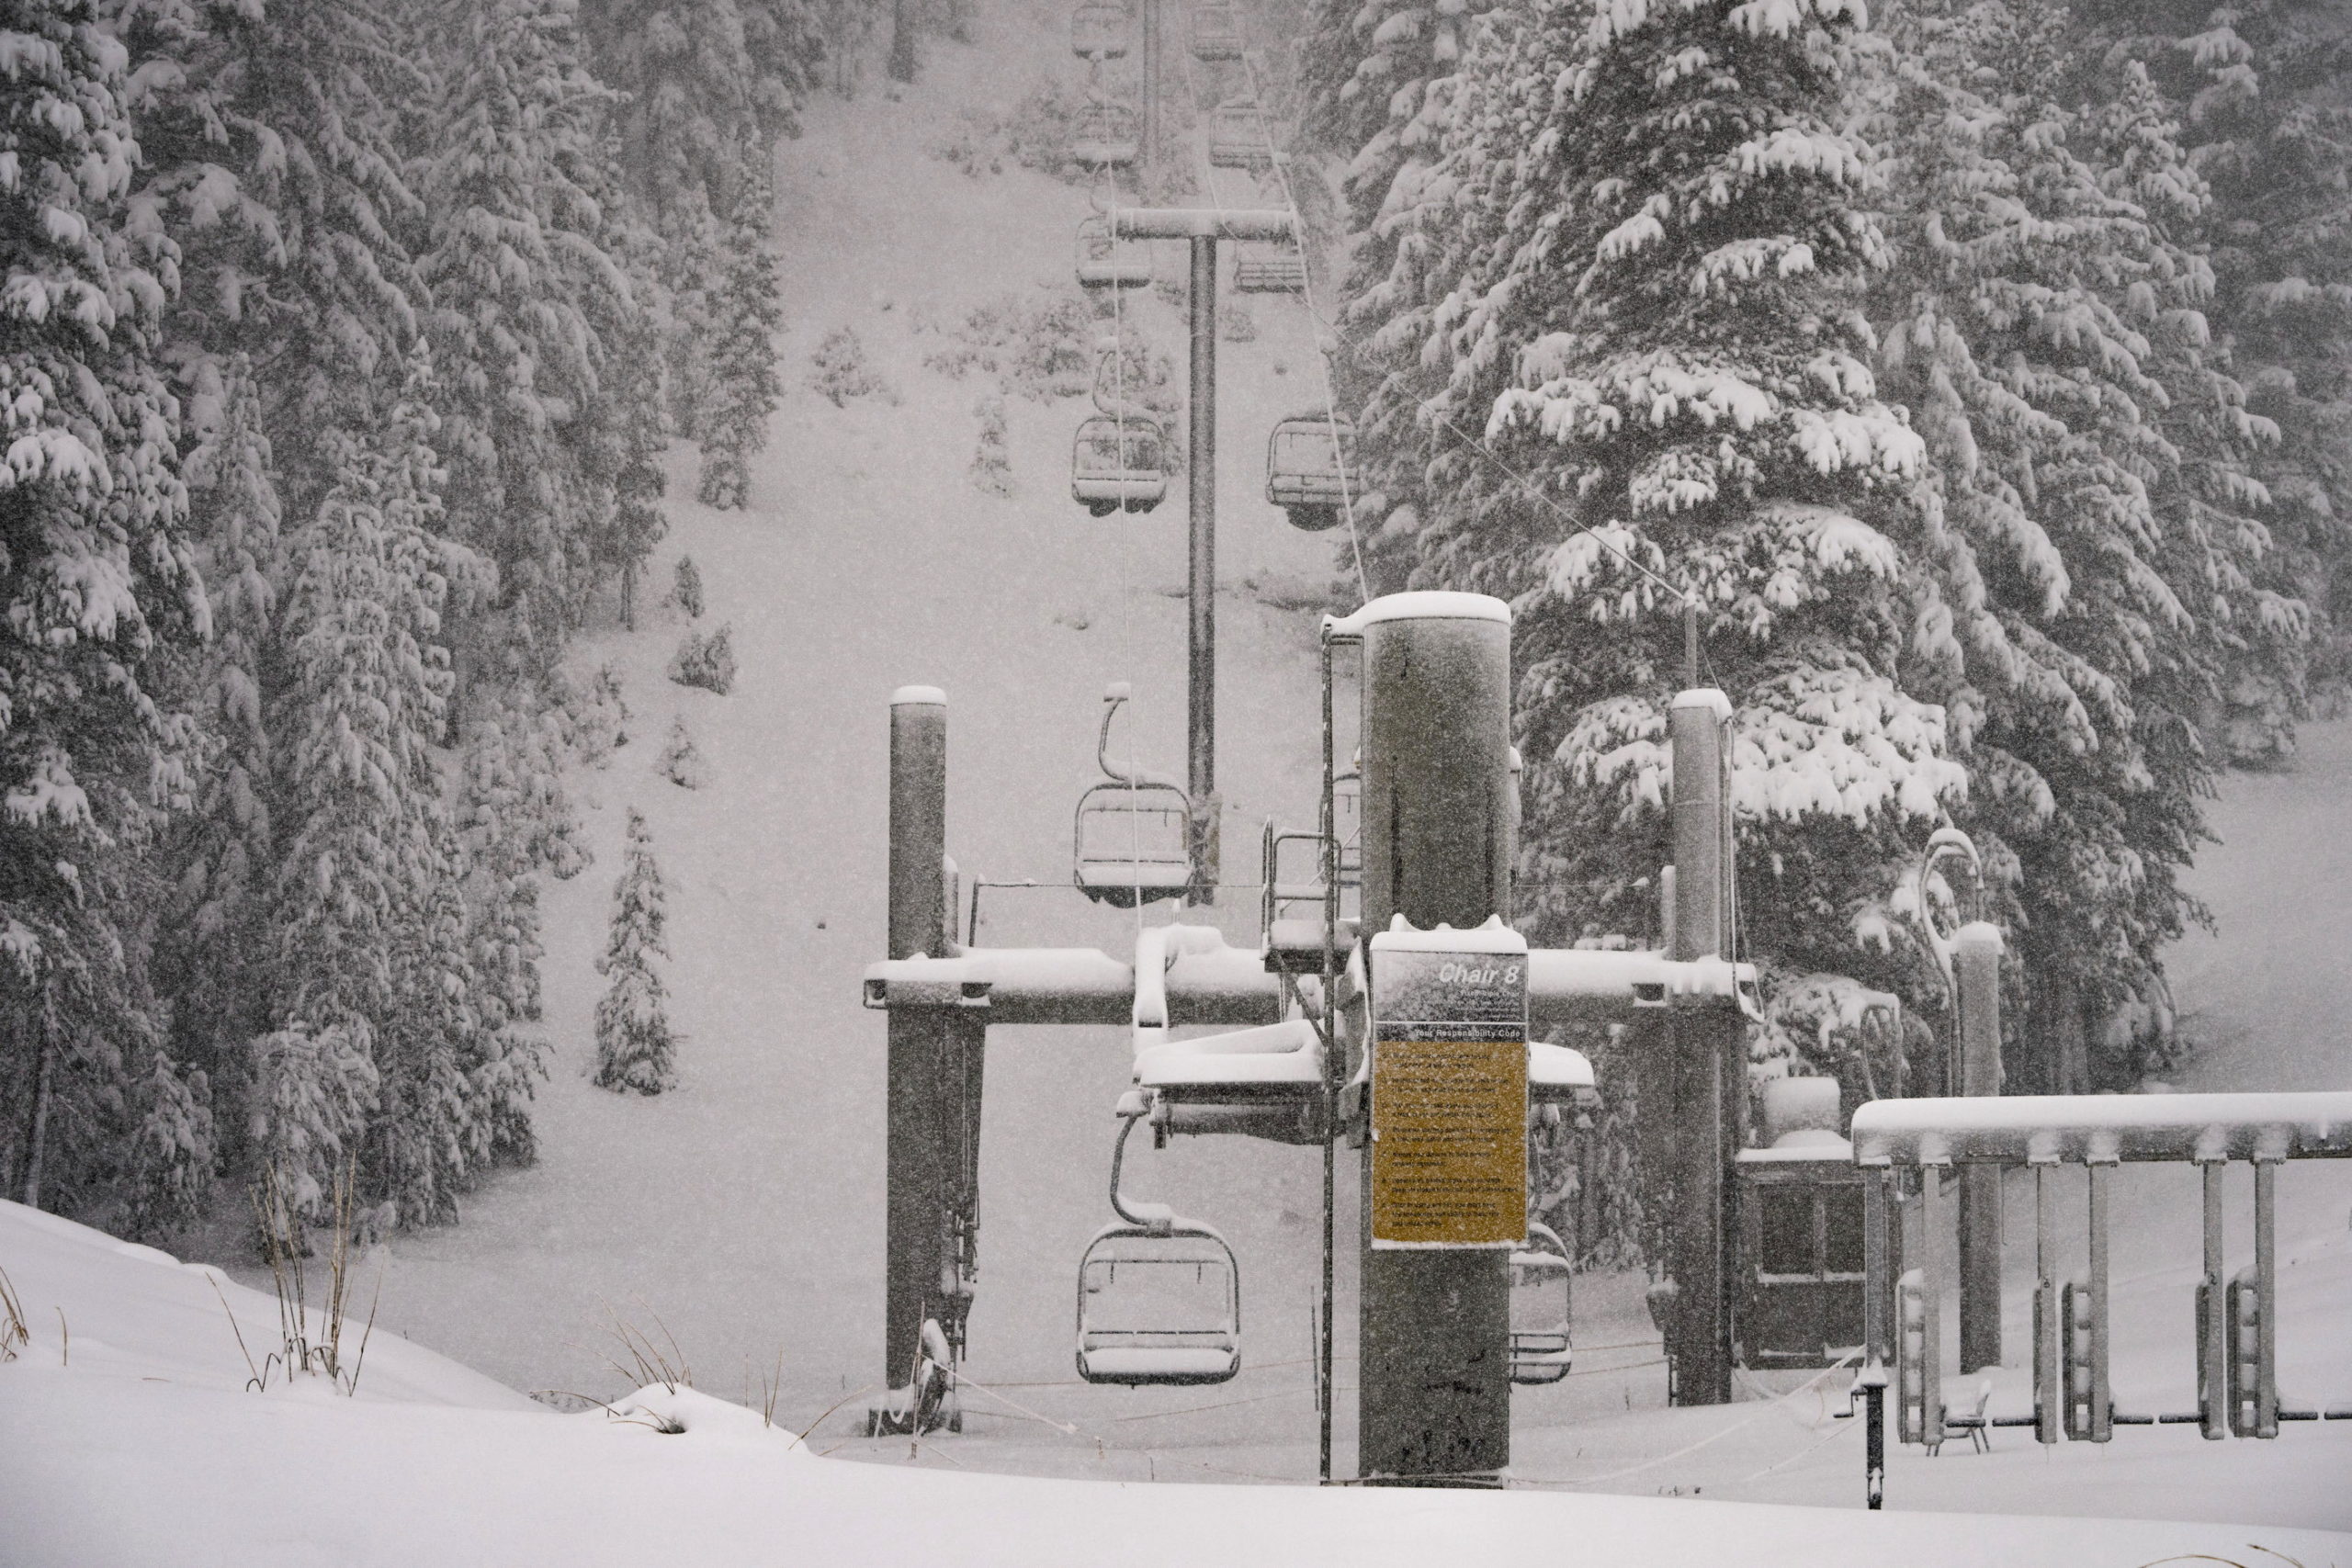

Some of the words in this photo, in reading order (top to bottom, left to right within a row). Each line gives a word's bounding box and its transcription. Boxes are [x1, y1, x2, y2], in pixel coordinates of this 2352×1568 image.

[1440, 963, 1499, 984] Chair
[1505, 964, 1521, 985] 8
[1416, 1029, 1433, 1038] Your
[1436, 1029, 1496, 1039] Responsibility
[1498, 1029, 1521, 1038] Code
